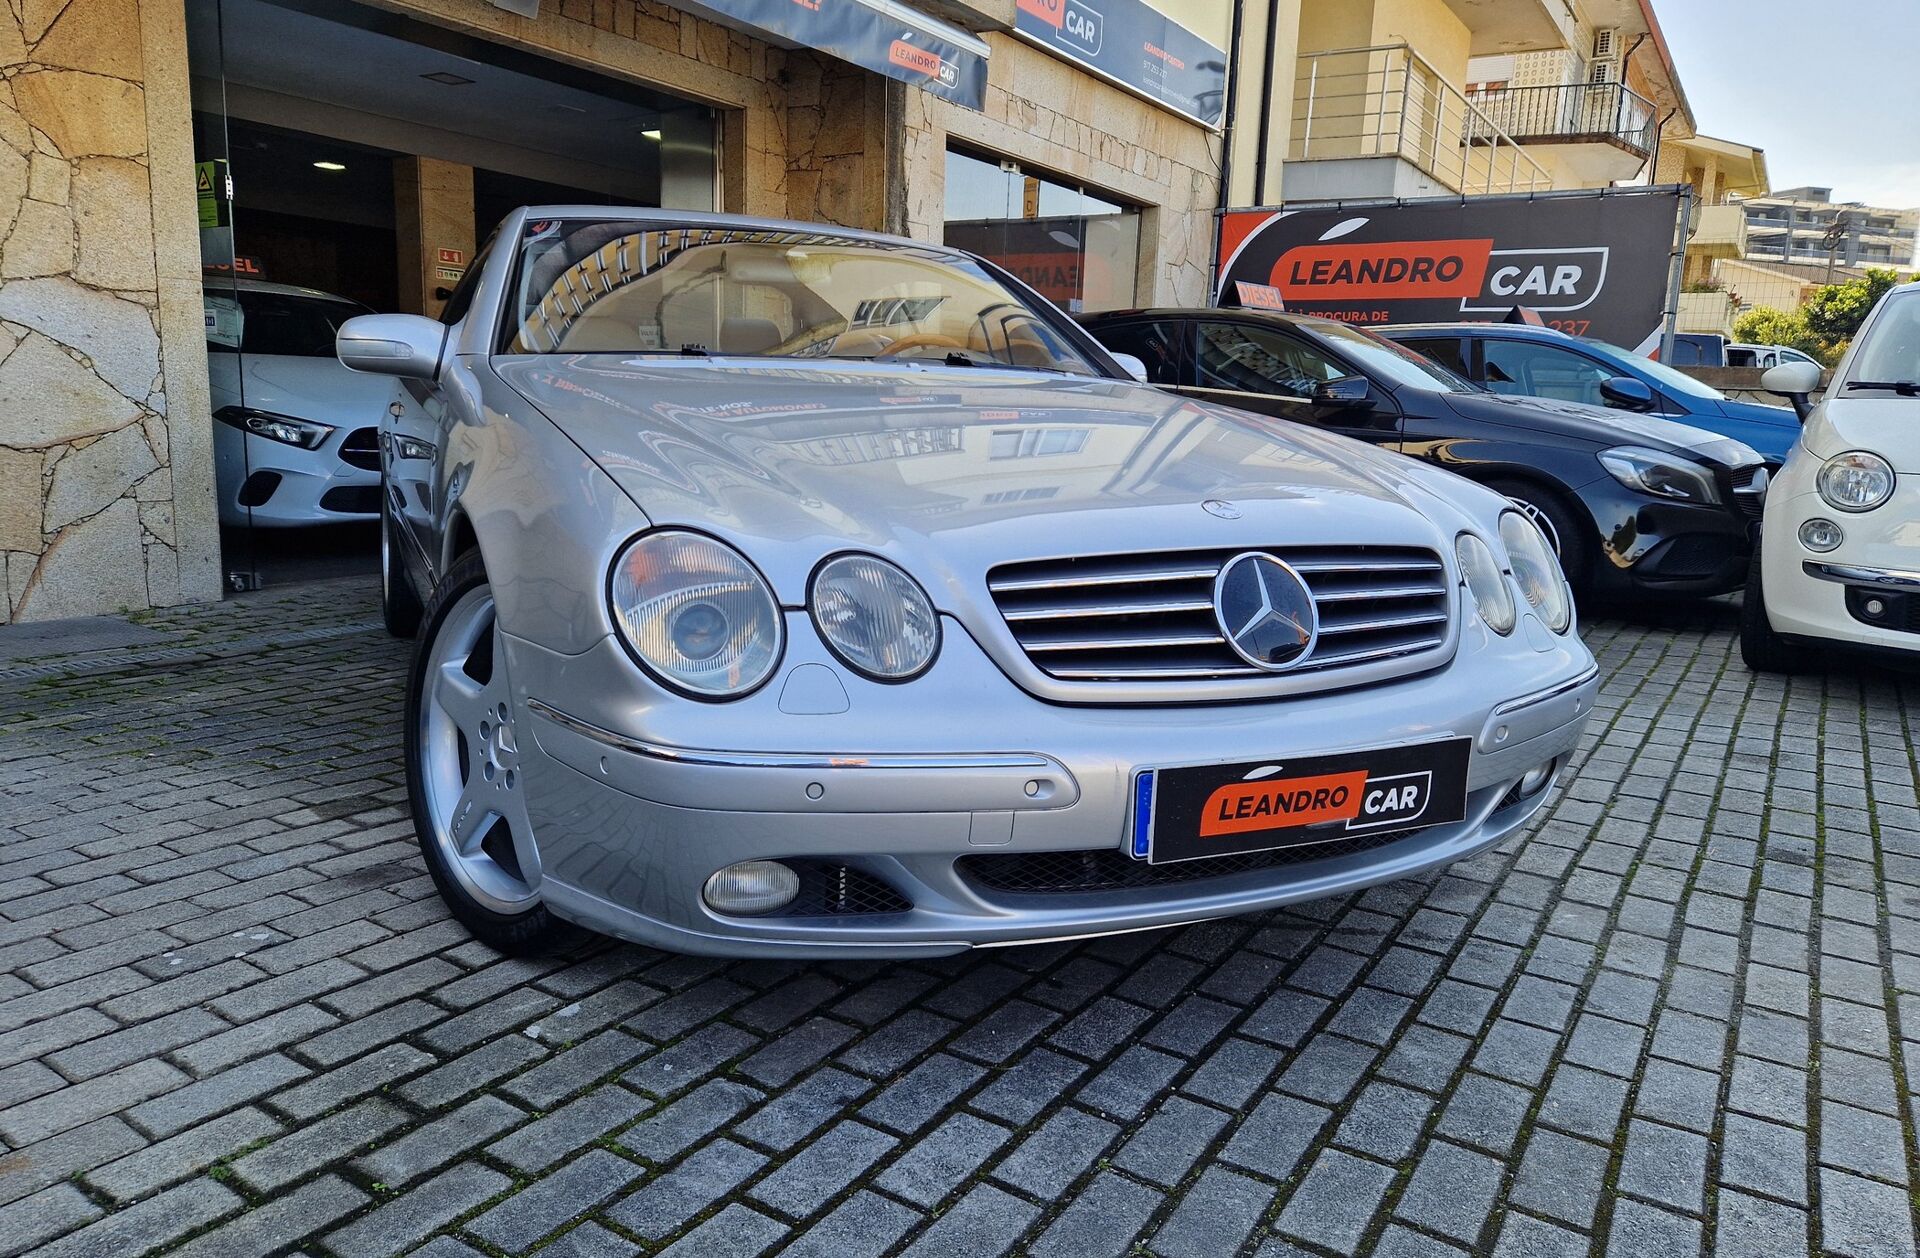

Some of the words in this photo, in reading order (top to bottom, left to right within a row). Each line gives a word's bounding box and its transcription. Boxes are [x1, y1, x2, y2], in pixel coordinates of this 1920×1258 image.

[1065, 10, 1096, 43] CAR
[895, 47, 937, 69] LEANDRO
[939, 65, 955, 83] CAR
[1289, 255, 1464, 286] LEANDRO
[1490, 265, 1583, 296] CAR
[1240, 284, 1284, 310] DIESEL
[1372, 311, 1389, 321] DE
[1218, 786, 1349, 821] LEANDRO
[1364, 785, 1418, 815] CAR
